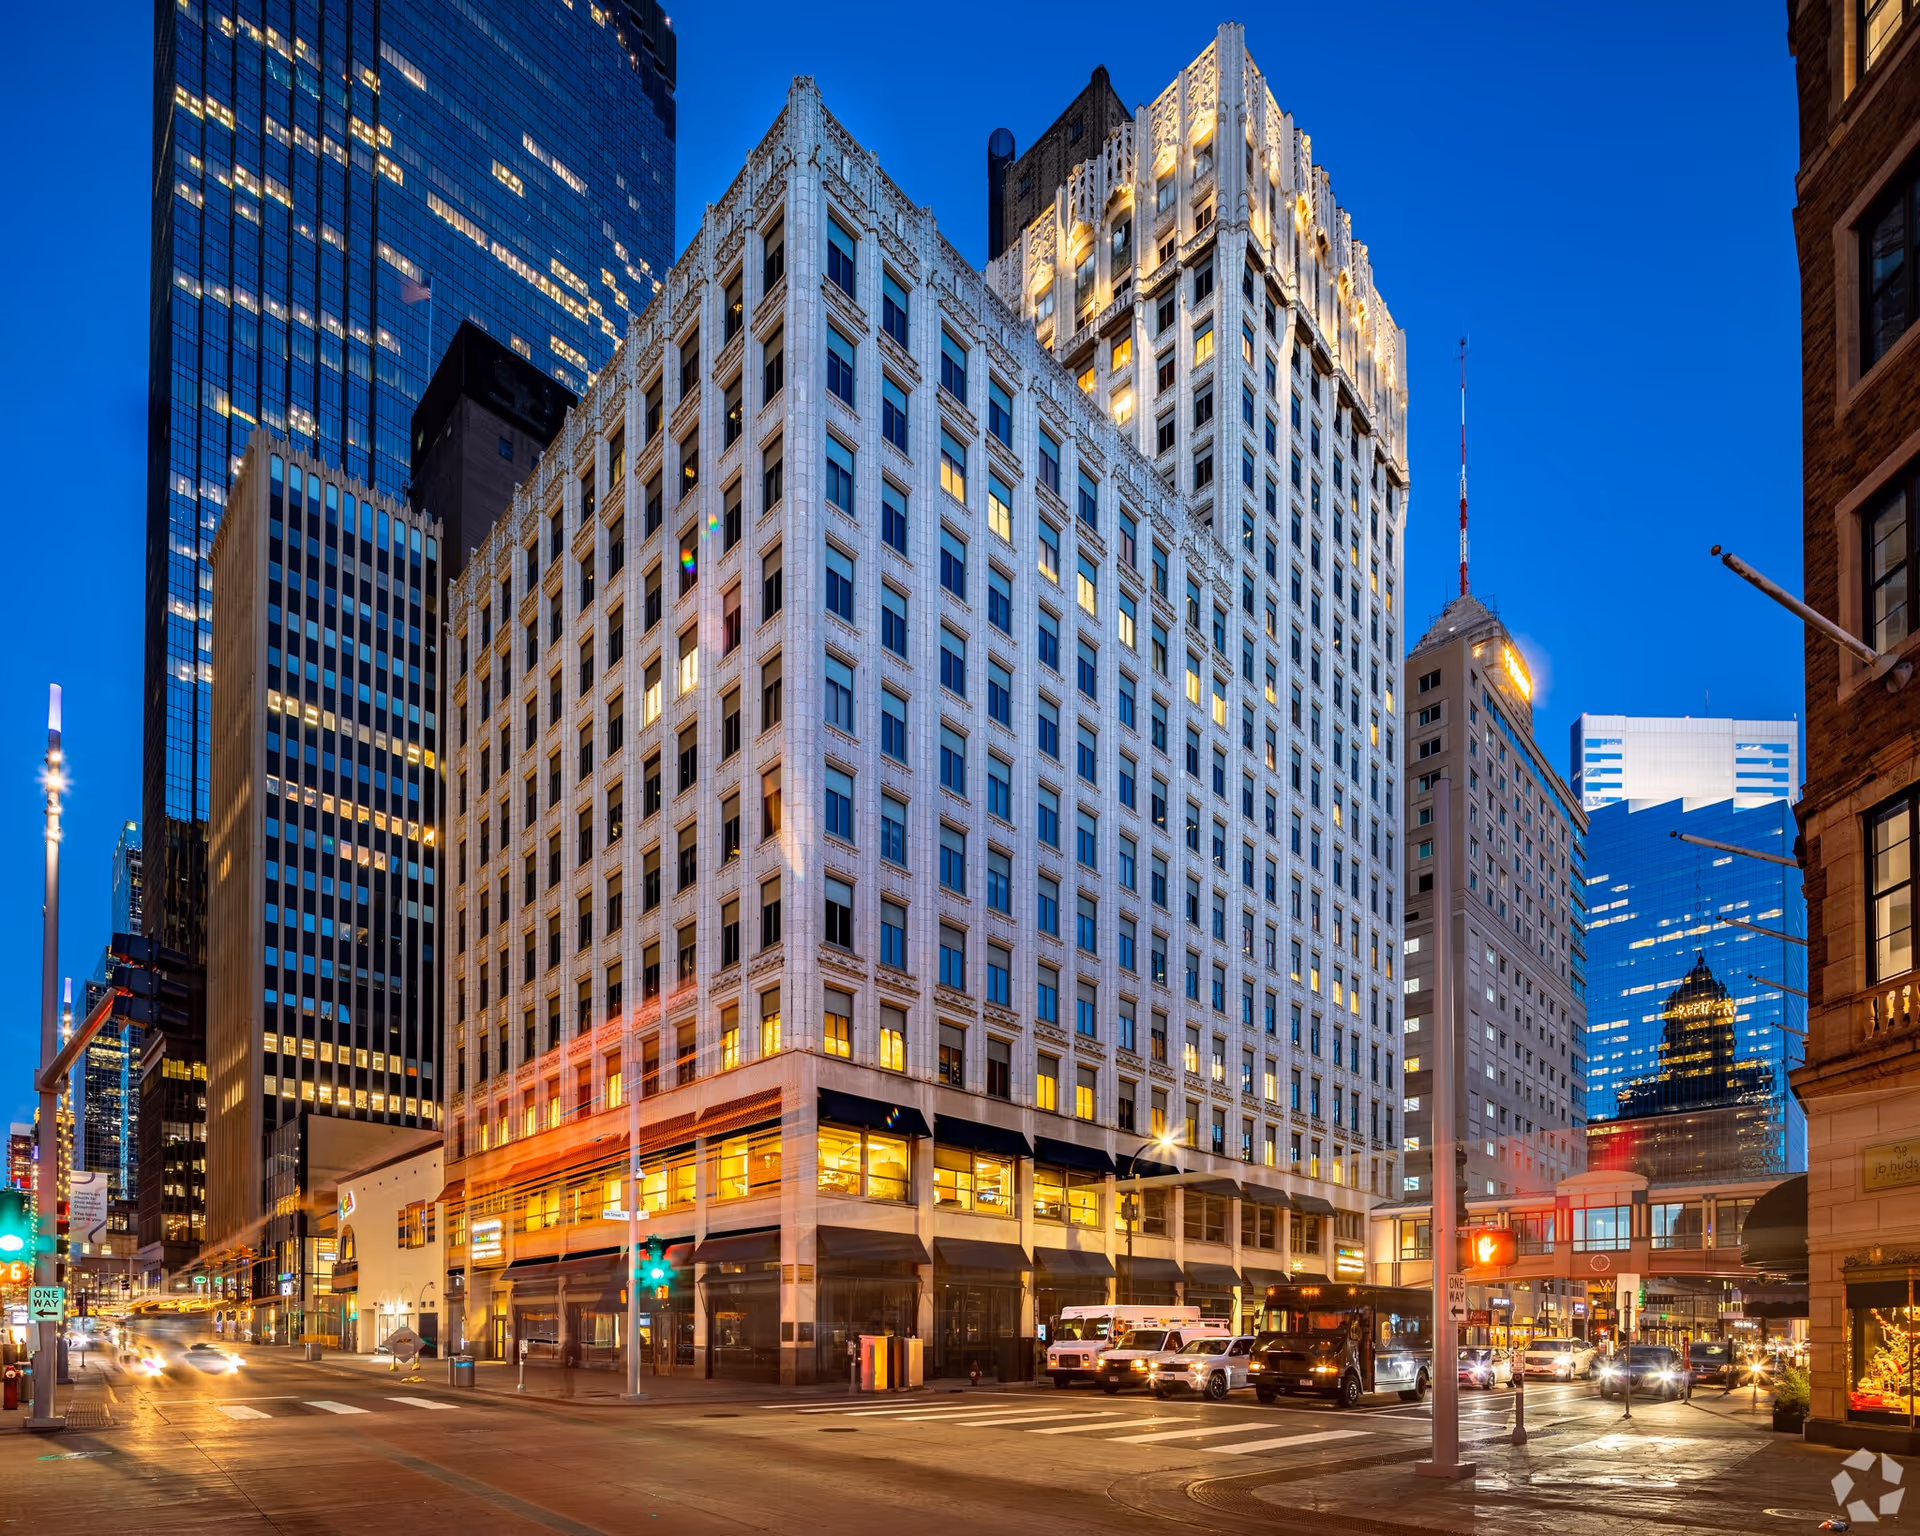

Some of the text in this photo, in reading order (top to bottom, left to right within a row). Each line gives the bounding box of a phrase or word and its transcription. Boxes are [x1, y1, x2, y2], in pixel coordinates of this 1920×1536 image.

[1872, 1162, 1886, 1180] jb
[10, 1263, 21, 1280] 6
[1449, 1277, 1464, 1289] ONE
[1600, 1279, 1616, 1290] W
[34, 1290, 59, 1298] ONE
[1449, 1290, 1464, 1303] WAY
[33, 1299, 59, 1308] WAY
